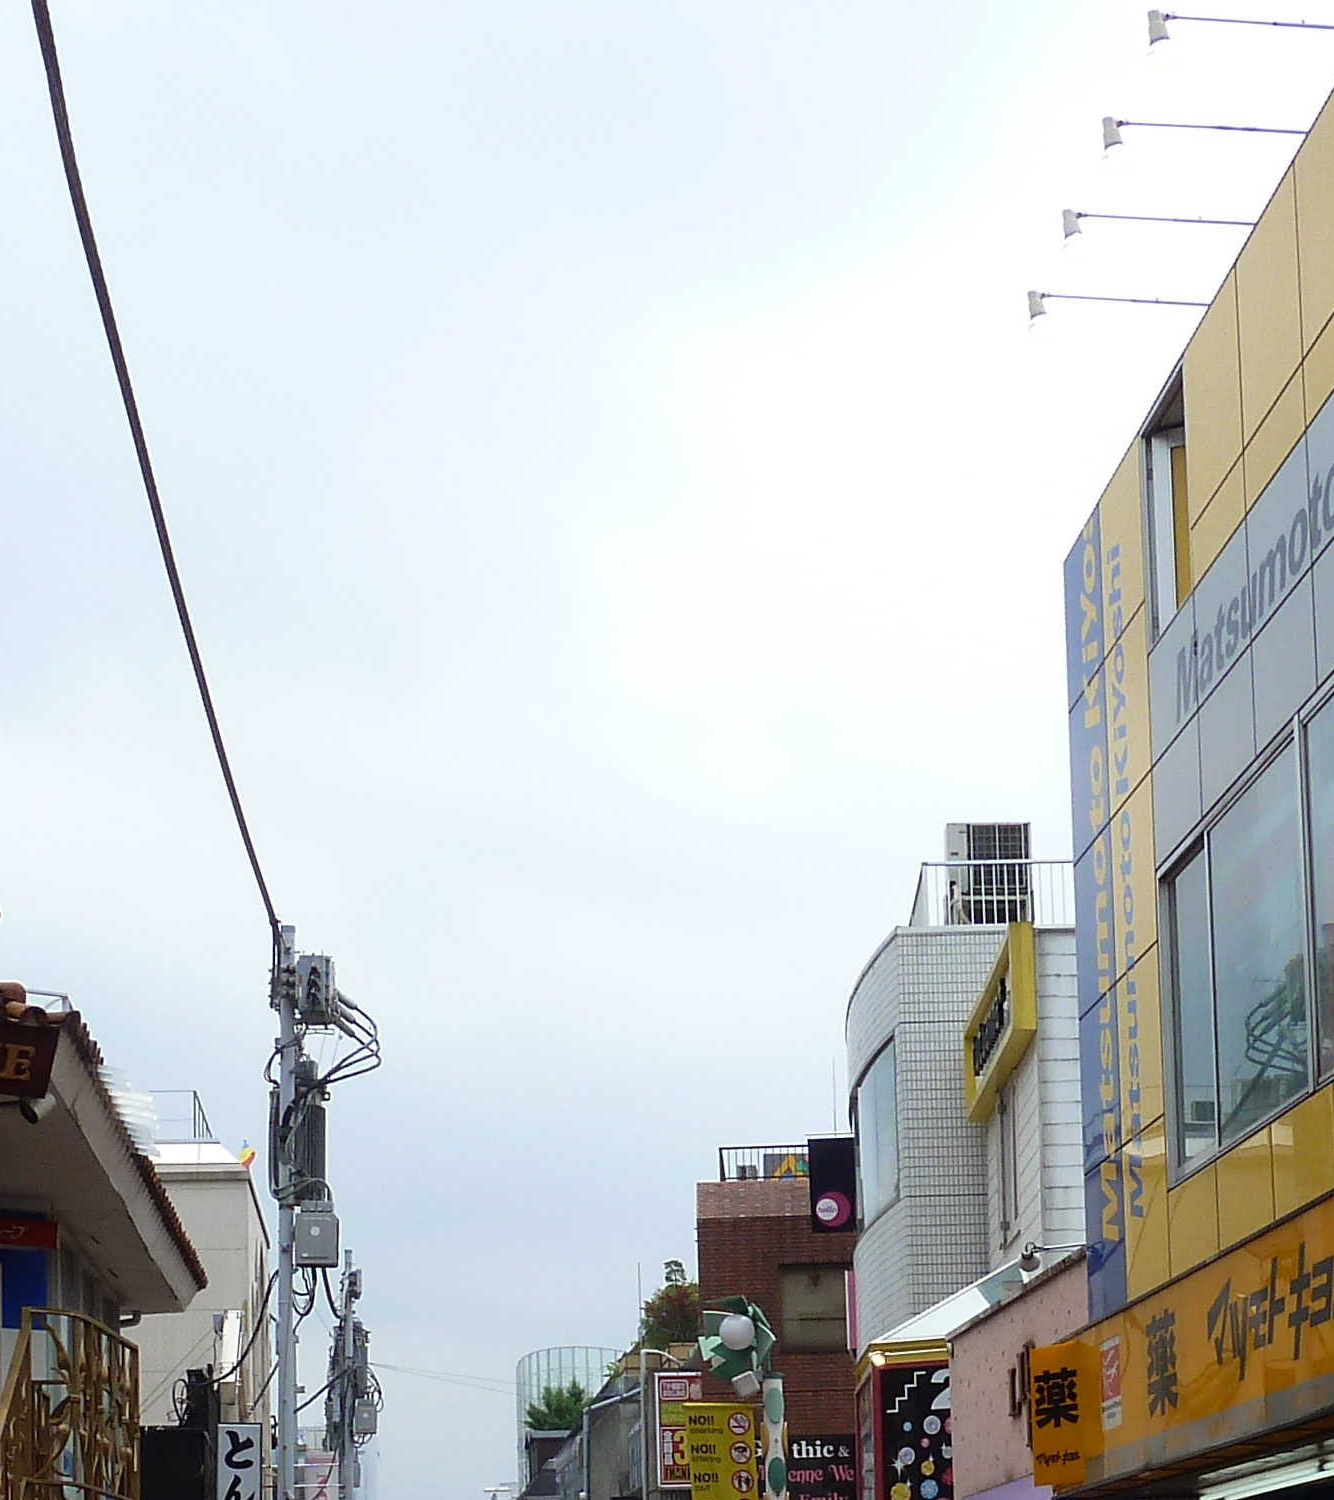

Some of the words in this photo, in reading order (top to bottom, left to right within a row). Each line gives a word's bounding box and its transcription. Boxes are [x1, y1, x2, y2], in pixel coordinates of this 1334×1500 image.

[1106, 543, 1131, 799] KiYoshi
[1085, 747, 1121, 1241] Matsumoto
[1117, 803, 1146, 1218] Matsumoto
[1034, 1367, 1080, 1429] 薬
[1145, 1309, 1179, 1418] 薬
[688, 1415, 715, 1426] NO!!
[691, 1444, 716, 1454] NO!!
[693, 1473, 719, 1483] NO!!
